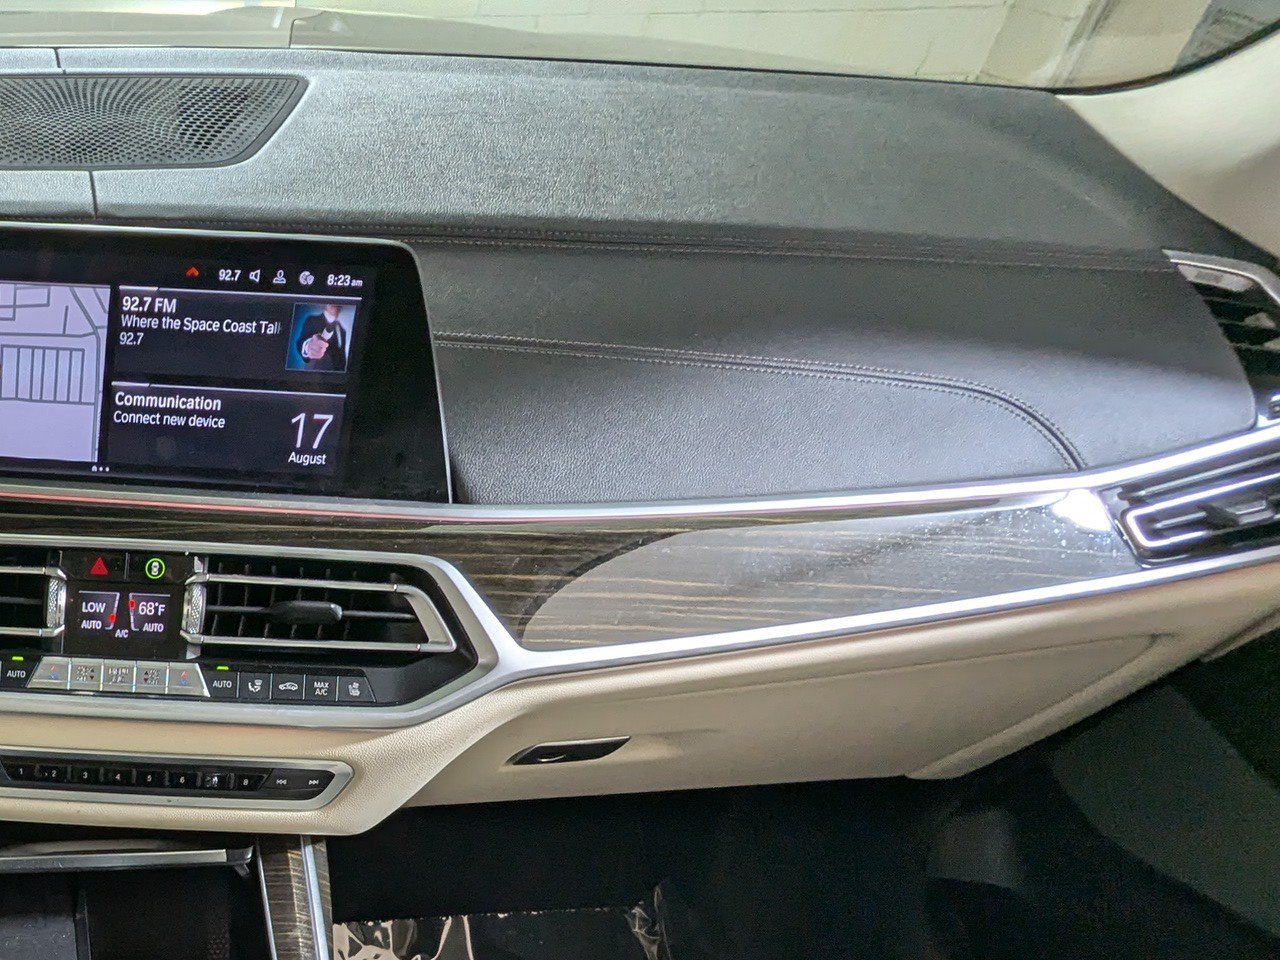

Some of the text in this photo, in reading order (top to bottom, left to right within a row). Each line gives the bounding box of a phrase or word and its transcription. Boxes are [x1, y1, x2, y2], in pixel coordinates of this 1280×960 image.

[218, 269, 242, 281] 92.7
[122, 296, 177, 313] 92.7 FM
[121, 314, 159, 329] Where
[161, 315, 181, 330] the
[183, 317, 220, 333] Space
[222, 319, 256, 333] Coast
[119, 332, 144, 345] 92.7
[114, 391, 222, 411] Communication
[113, 410, 226, 429] Connect new device
[291, 412, 334, 450] 17
[288, 451, 327, 466] August
[82, 601, 106, 613] LOW
[138, 602, 166, 616] 68°F
[81, 620, 102, 629] AUTO
[143, 623, 164, 632] AUTO
[115, 629, 129, 638] A/C
[6, 670, 26, 678] AUTO
[213, 680, 232, 689] AUTO
[314, 681, 330, 689] MAX
[314, 688, 328, 696] A/C
[82, 771, 88, 779] 3
[147, 774, 152, 782] 5
[243, 778, 249, 786] 8
